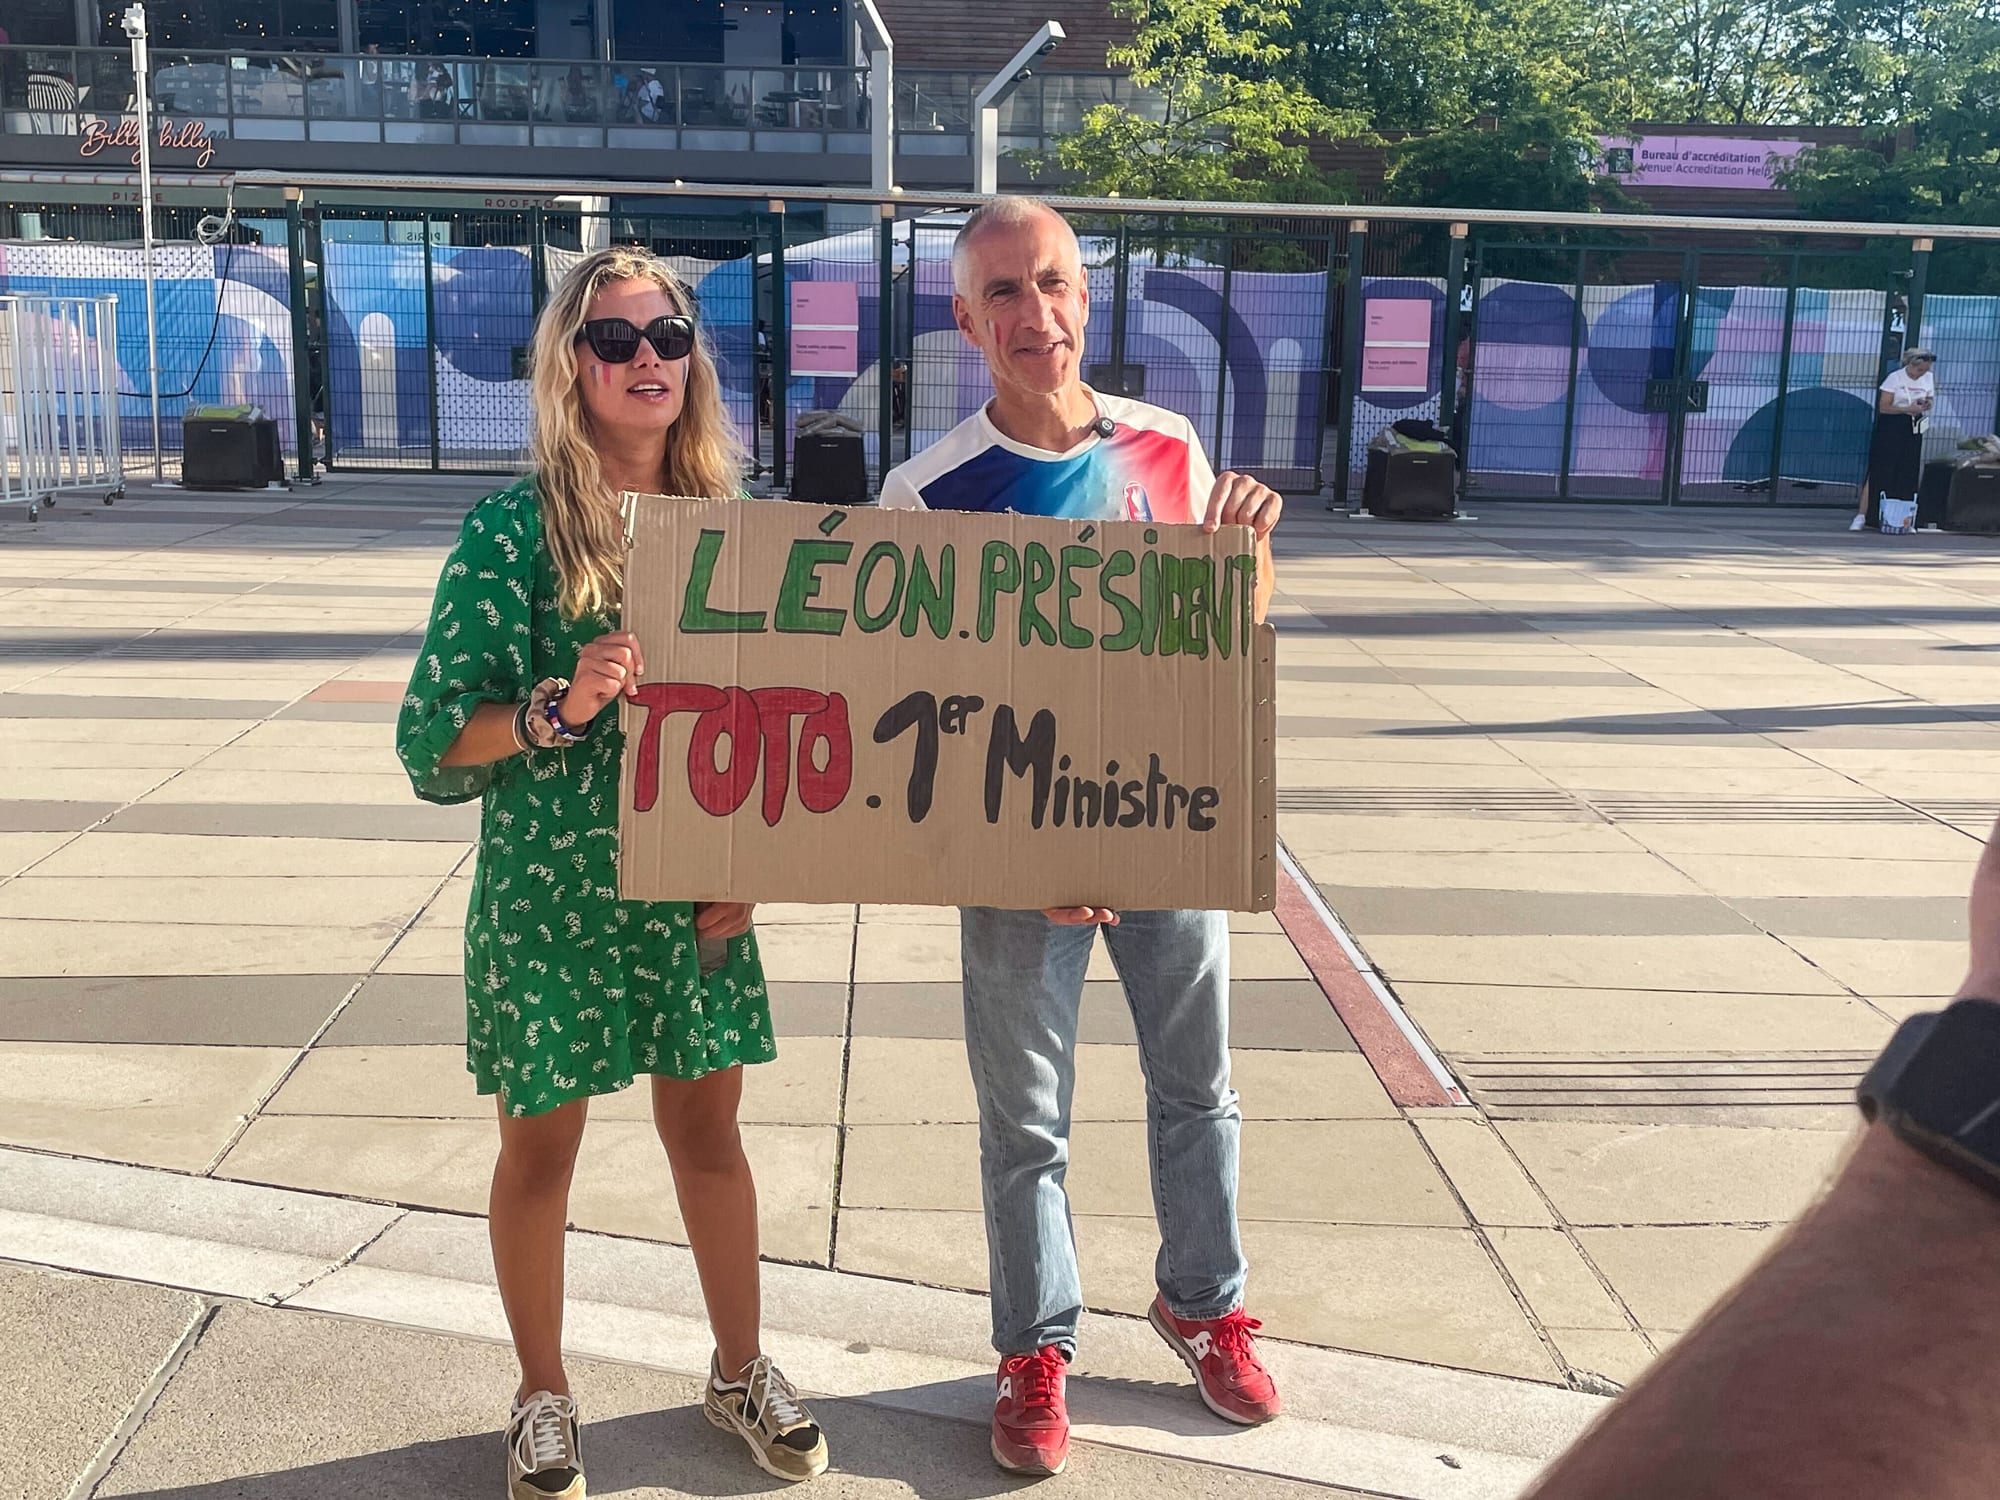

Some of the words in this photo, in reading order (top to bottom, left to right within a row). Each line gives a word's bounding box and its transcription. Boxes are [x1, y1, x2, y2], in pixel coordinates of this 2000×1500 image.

[159, 120, 215, 168] billy
[1641, 149, 1679, 160] Bureau
[1681, 150, 1761, 164] d'accréditation
[1675, 163, 1744, 176] Accreditation
[112, 192, 163, 202] PIZE
[873, 690, 984, 823] 1er
[984, 703, 1220, 832] Ministre
